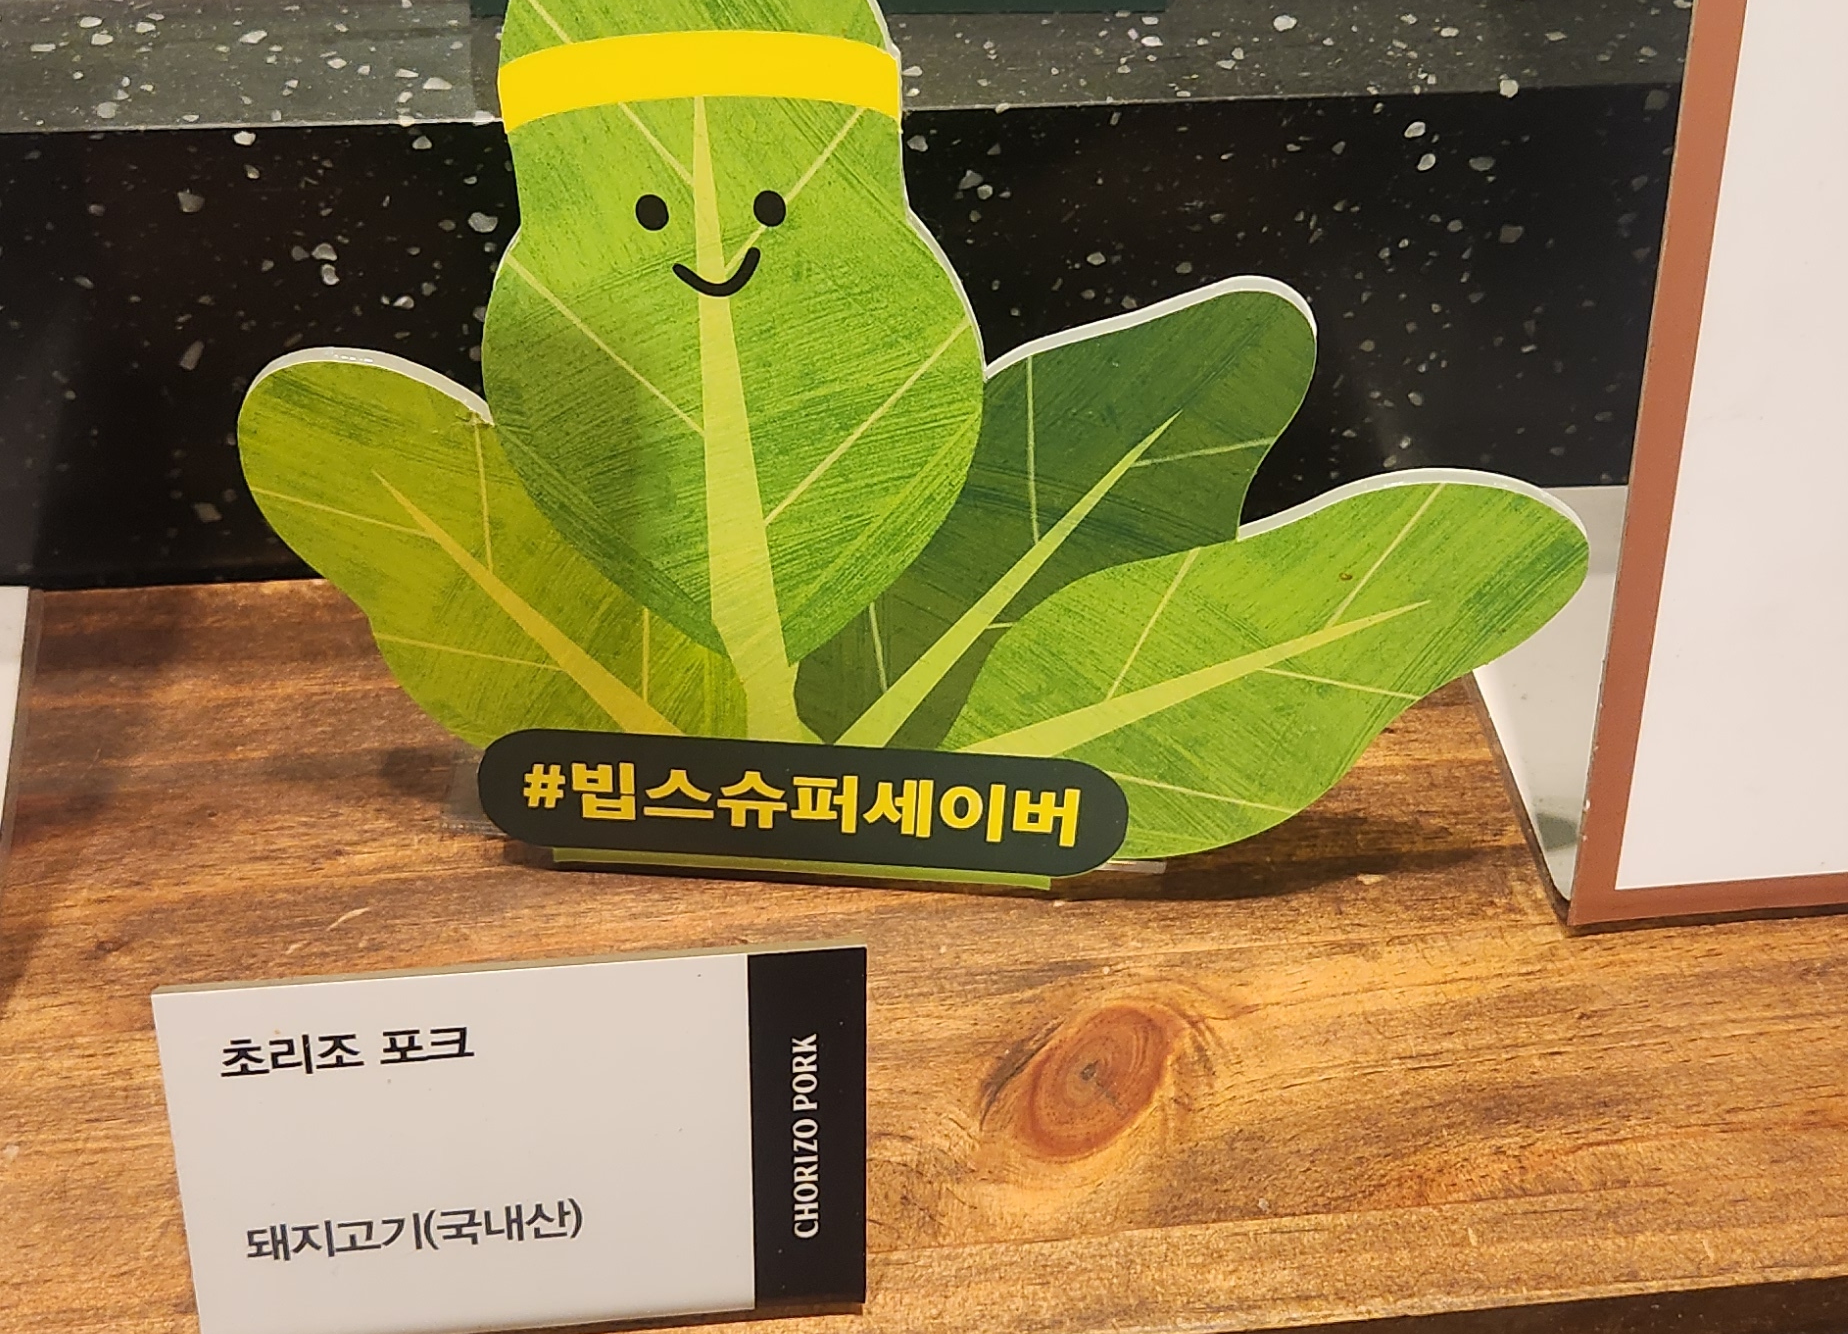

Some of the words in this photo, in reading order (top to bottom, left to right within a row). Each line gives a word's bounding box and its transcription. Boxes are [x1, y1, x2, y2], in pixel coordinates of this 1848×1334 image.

[523, 761, 1081, 848] #빕스슈퍼세이버
[220, 1033, 364, 1078] 초리조
[380, 1027, 475, 1065] 포크
[791, 1033, 818, 1111] PORK
[793, 1118, 819, 1238] CHORIZO
[246, 1198, 583, 1262] 돼지고기(국내산)
